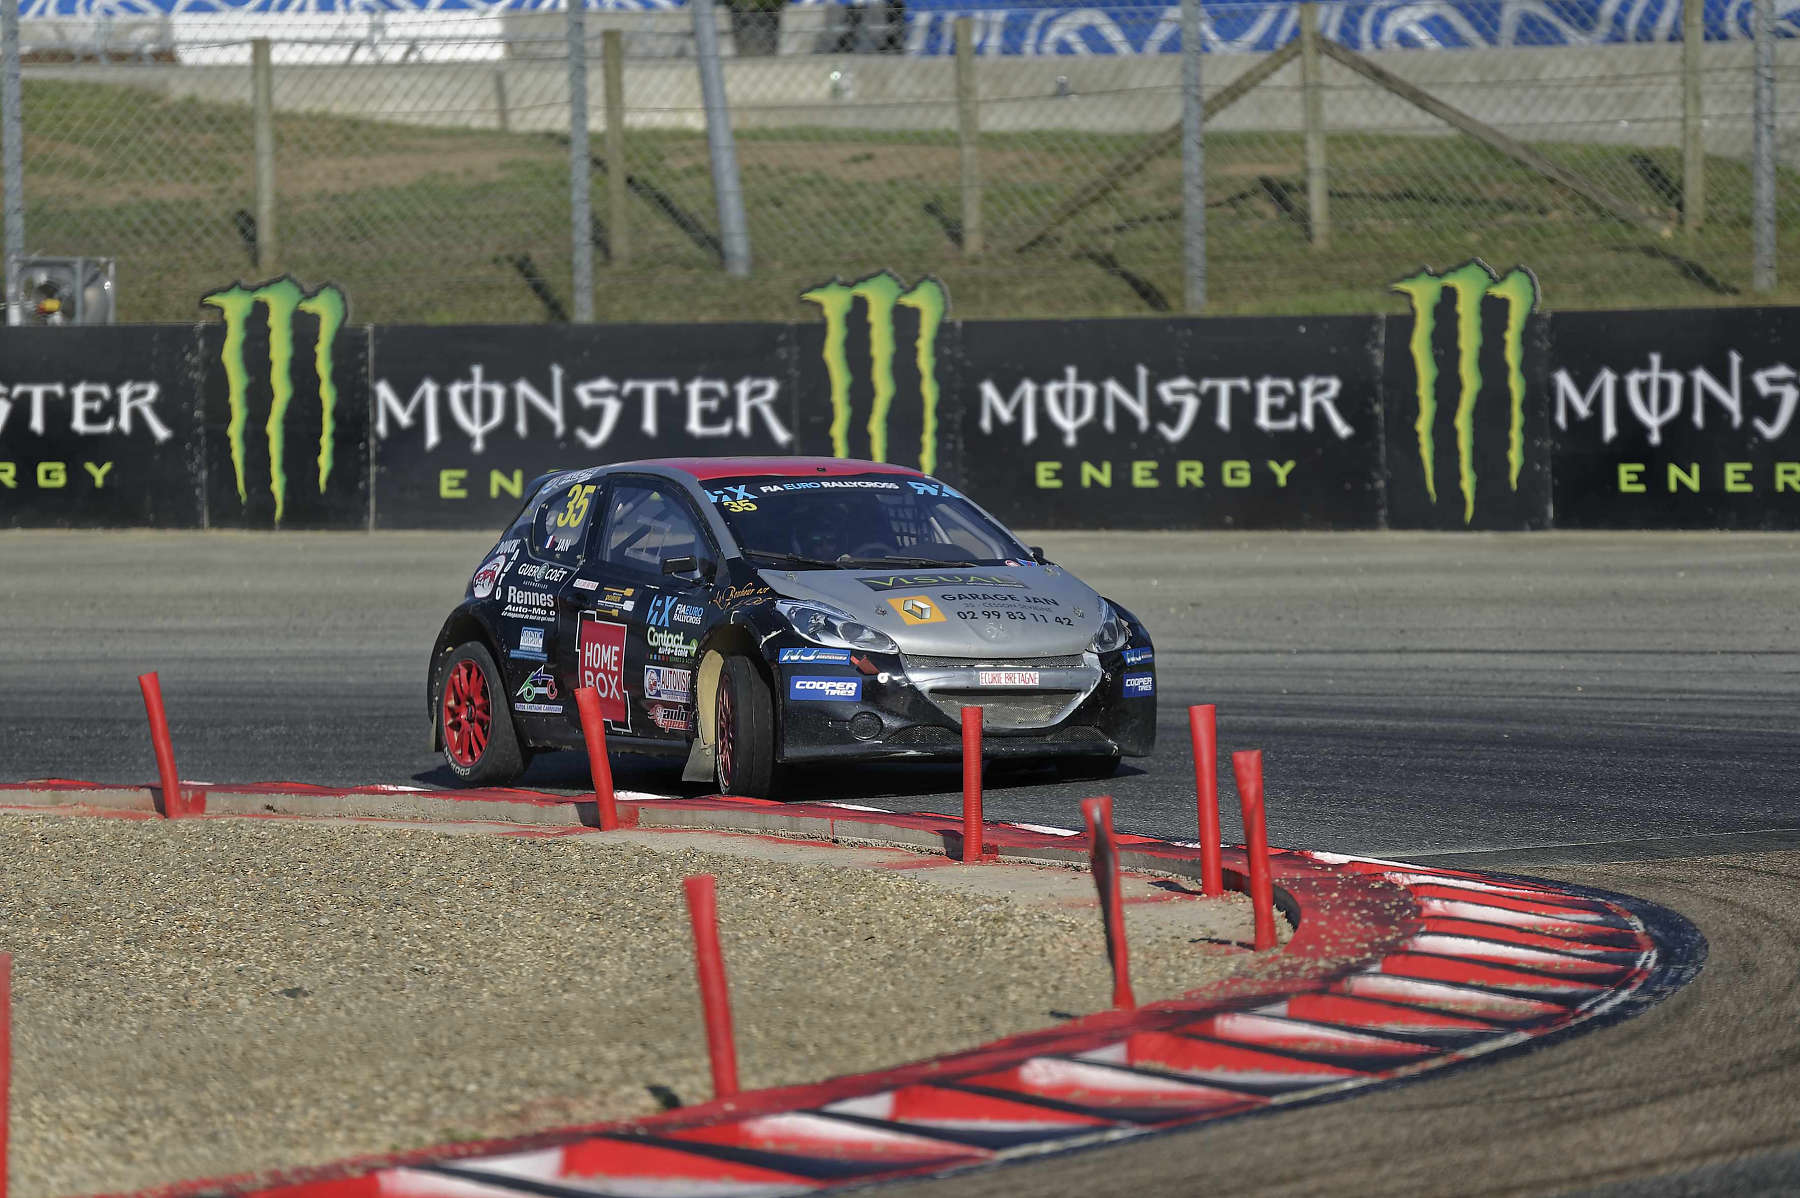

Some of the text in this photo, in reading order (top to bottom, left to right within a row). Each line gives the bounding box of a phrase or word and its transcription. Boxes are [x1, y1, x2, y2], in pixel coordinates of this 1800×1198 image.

[979, 364, 1355, 448] MONSTER
[1552, 350, 1800, 446] MONS
[0, 380, 173, 443] TER
[375, 364, 793, 453] MONSTER
[1036, 459, 1297, 489] ENERGY
[760, 481, 899, 493] FIA EURO RALLYCROSS
[557, 484, 597, 528] 35
[723, 500, 758, 512] 35
[555, 539, 572, 552] JAN
[508, 586, 554, 607] Rennes
[940, 594, 1060, 606] GARAGE JAN
[504, 604, 556, 616] Auto-Moo
[672, 614, 700, 624] RALLYCROSS
[957, 610, 1074, 626] 02 99 83 11 42
[647, 626, 684, 646] Contact
[584, 642, 620, 672] HOME
[585, 670, 620, 700] BOX
[795, 680, 858, 690] COOPER
[981, 672, 1038, 684] ECURIE BRETAGNE
[1126, 677, 1152, 687] COOPER
